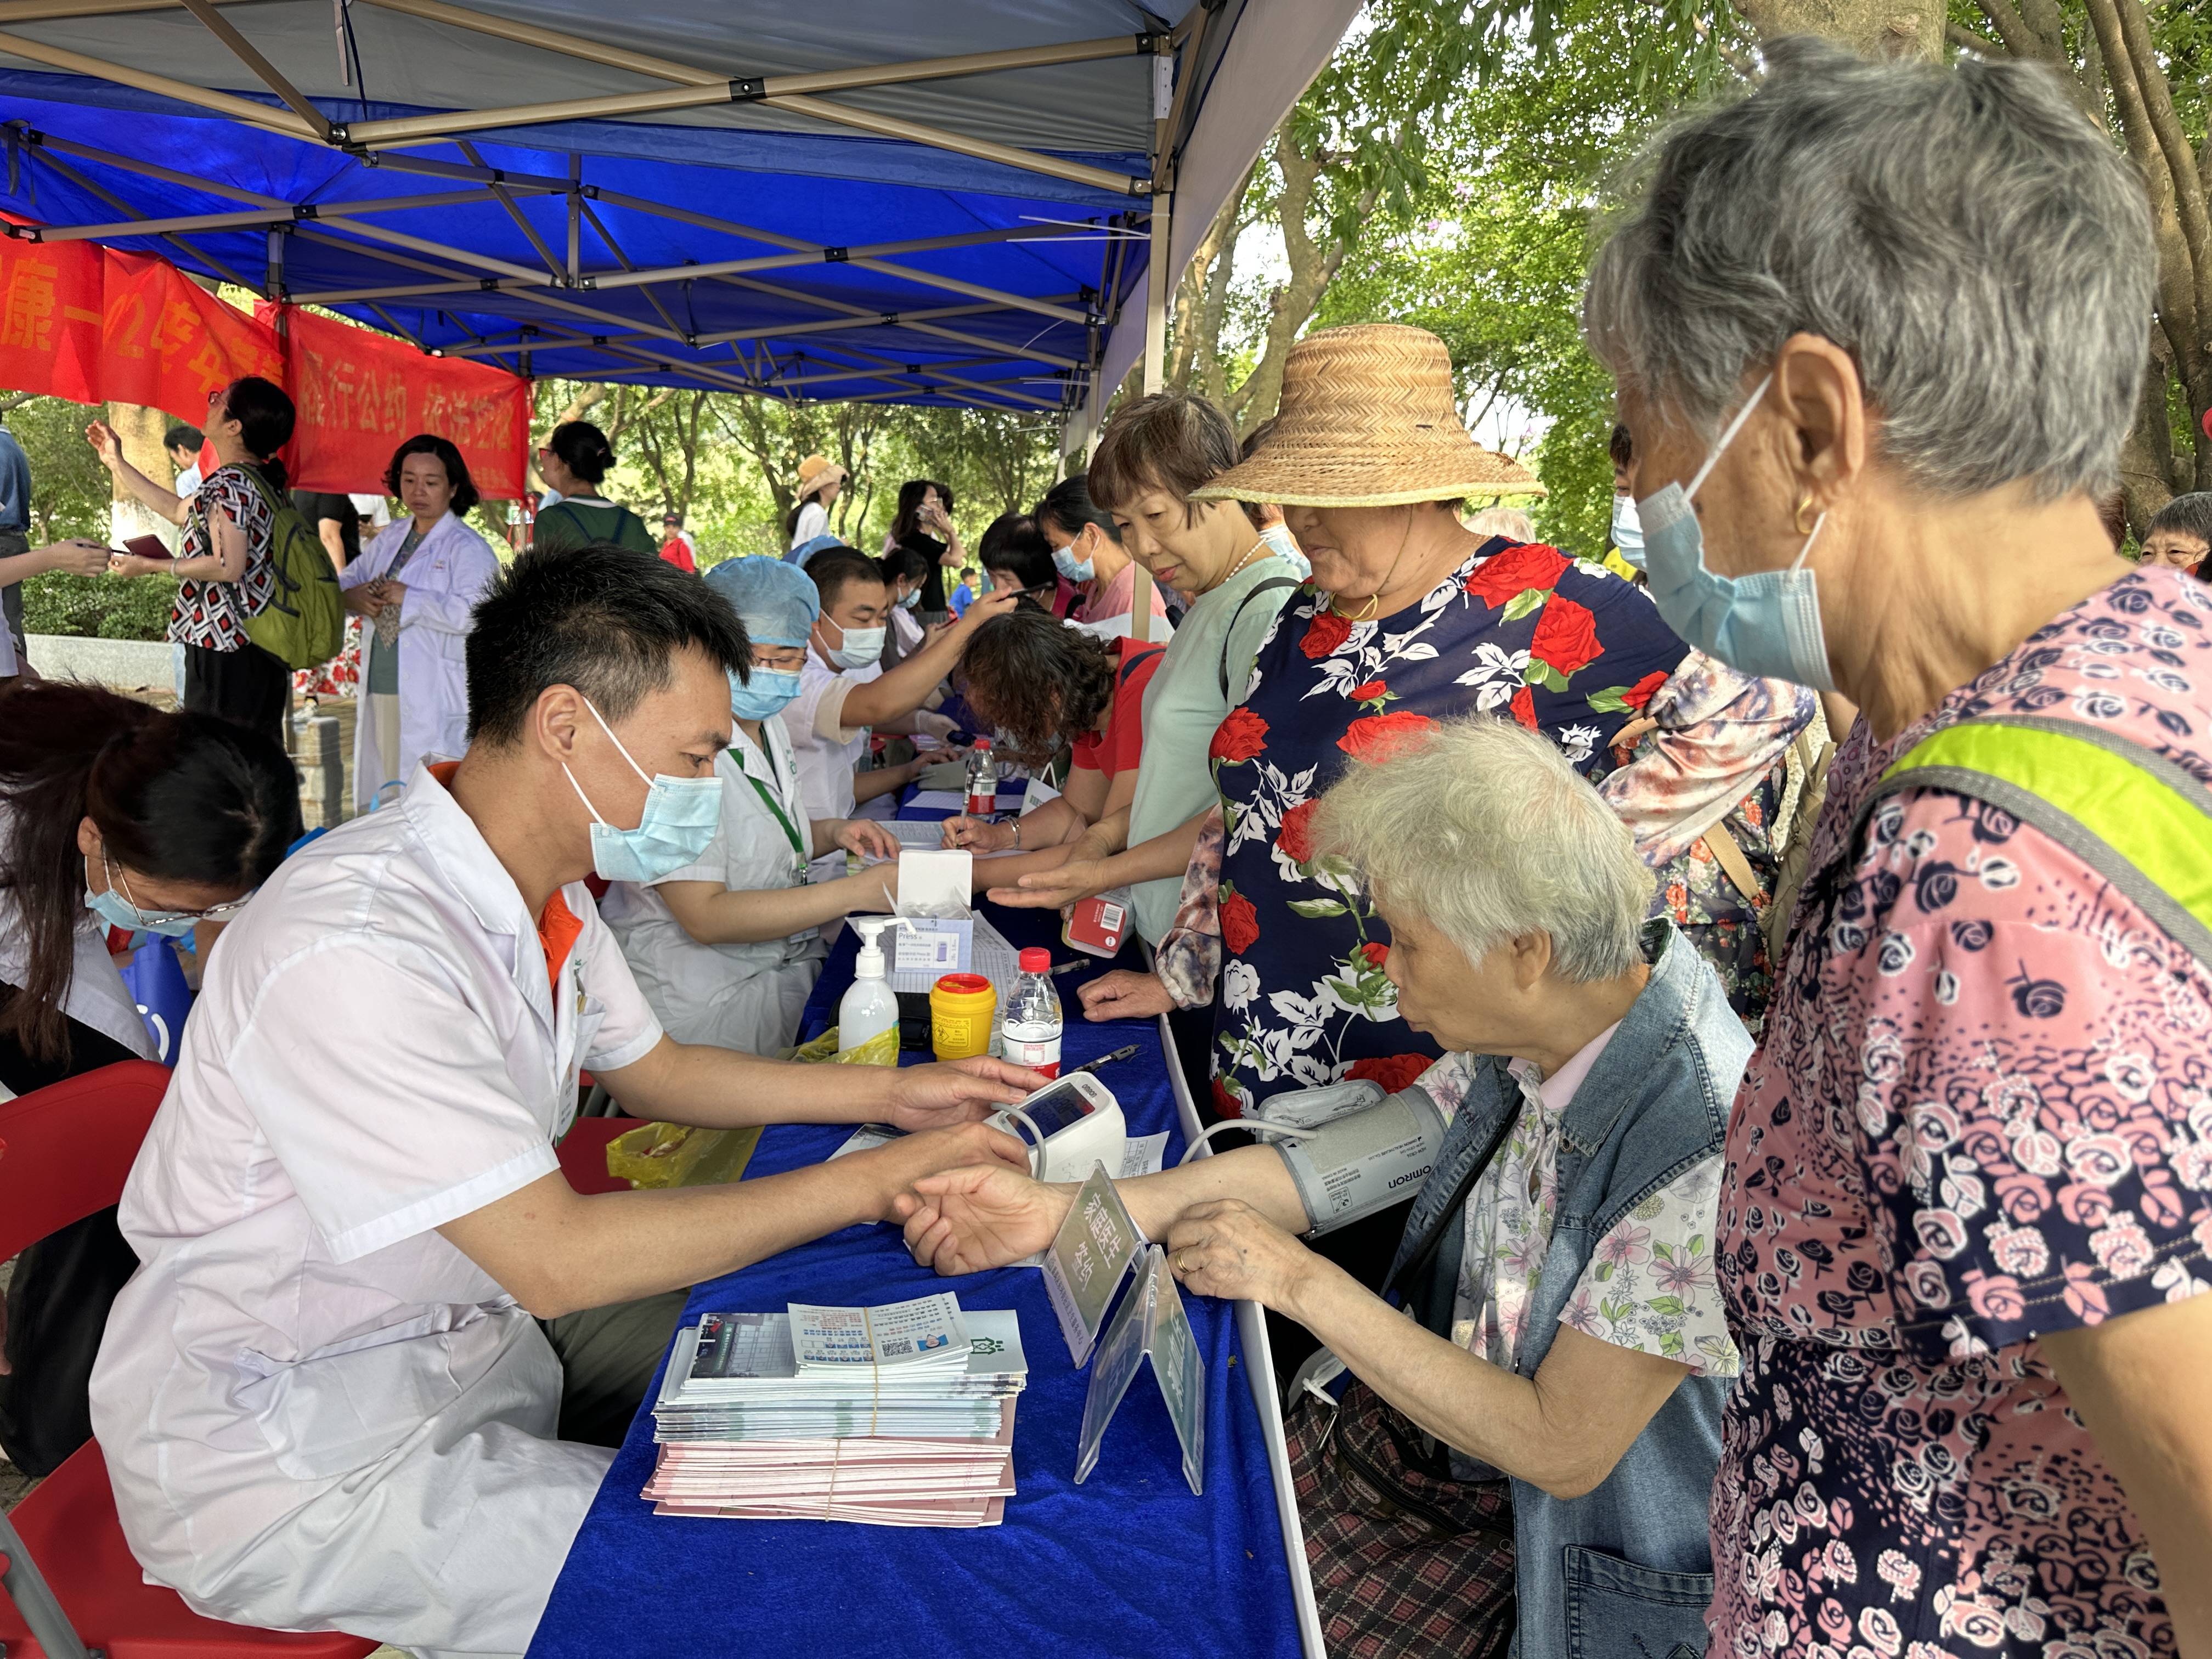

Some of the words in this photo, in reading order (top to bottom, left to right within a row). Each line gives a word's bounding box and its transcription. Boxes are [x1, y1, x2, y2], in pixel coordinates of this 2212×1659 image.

[1071, 1240, 1094, 1292] 签约
[1084, 1192, 1121, 1269] 家庭医生
[1167, 1302, 1186, 1413] 测血压
